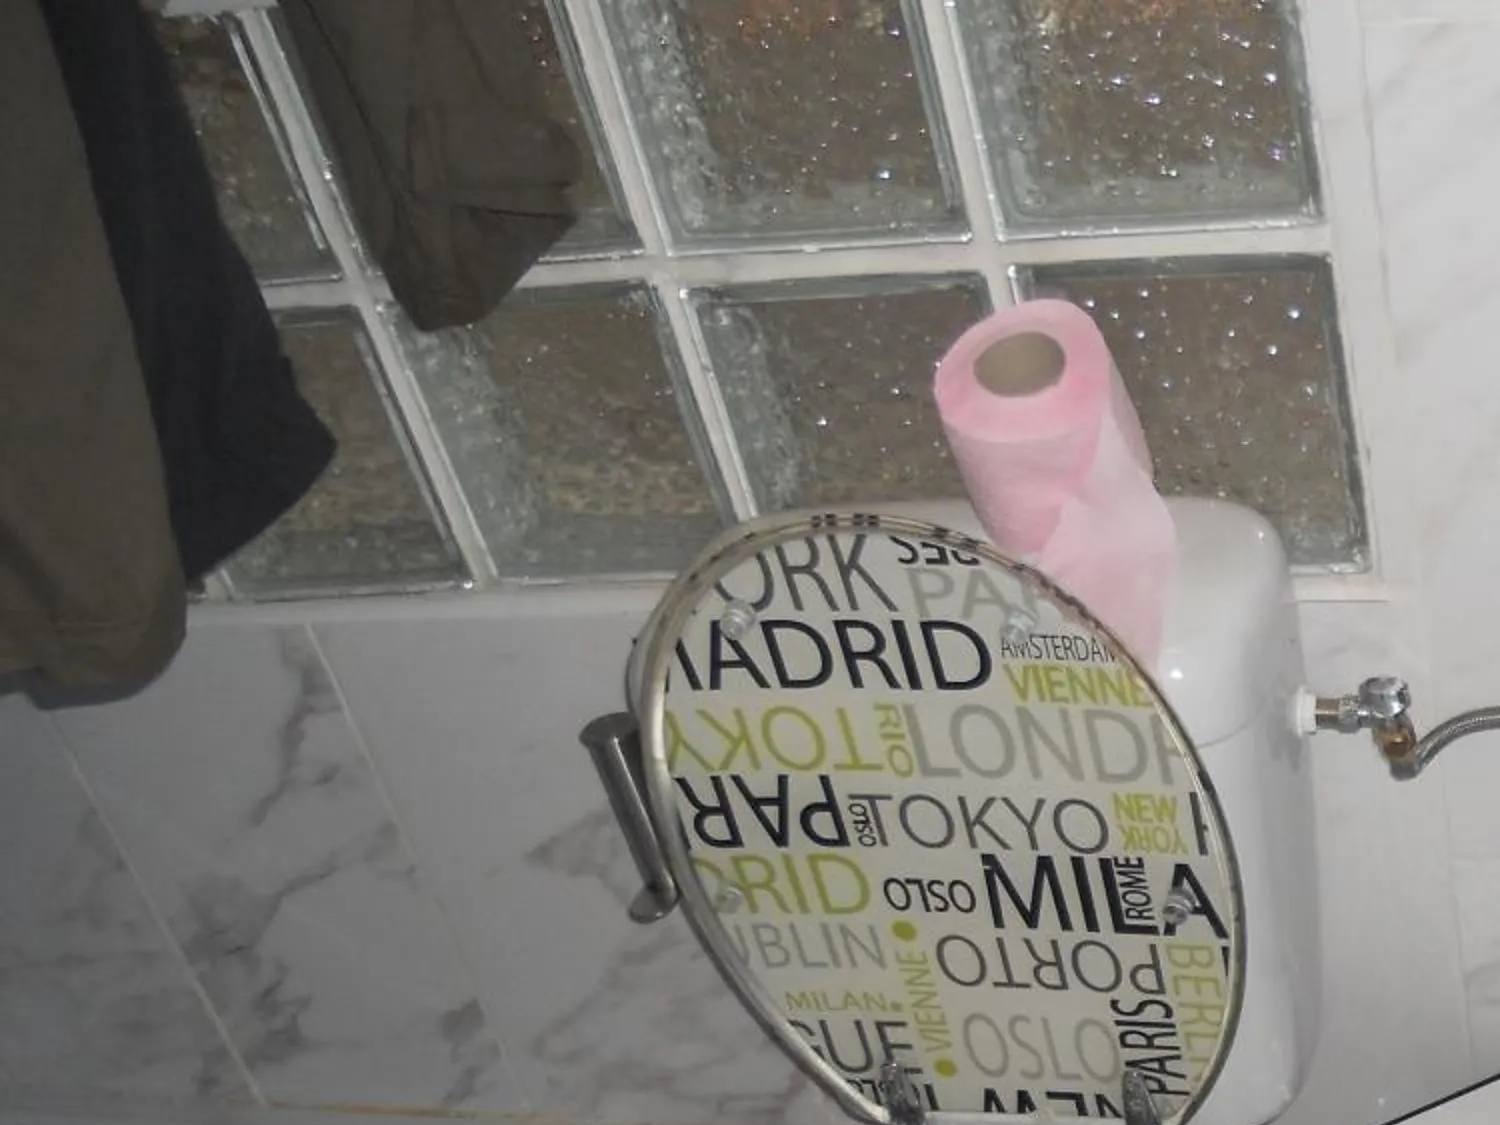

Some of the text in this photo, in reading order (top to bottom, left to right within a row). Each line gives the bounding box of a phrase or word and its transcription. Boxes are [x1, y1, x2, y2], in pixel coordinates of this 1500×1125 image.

[873, 704, 914, 778] RIO
[848, 793, 1109, 854] TOKYO
[849, 803, 877, 848] OSLO
[1111, 792, 1177, 822] NEW
[1118, 825, 1188, 855] YORK
[883, 877, 977, 913] OSLO
[1113, 856, 1156, 928] ROME
[936, 934, 1167, 995] PORTO
[897, 950, 954, 1054] VIENNE
[963, 1013, 1120, 1082] OSLO
